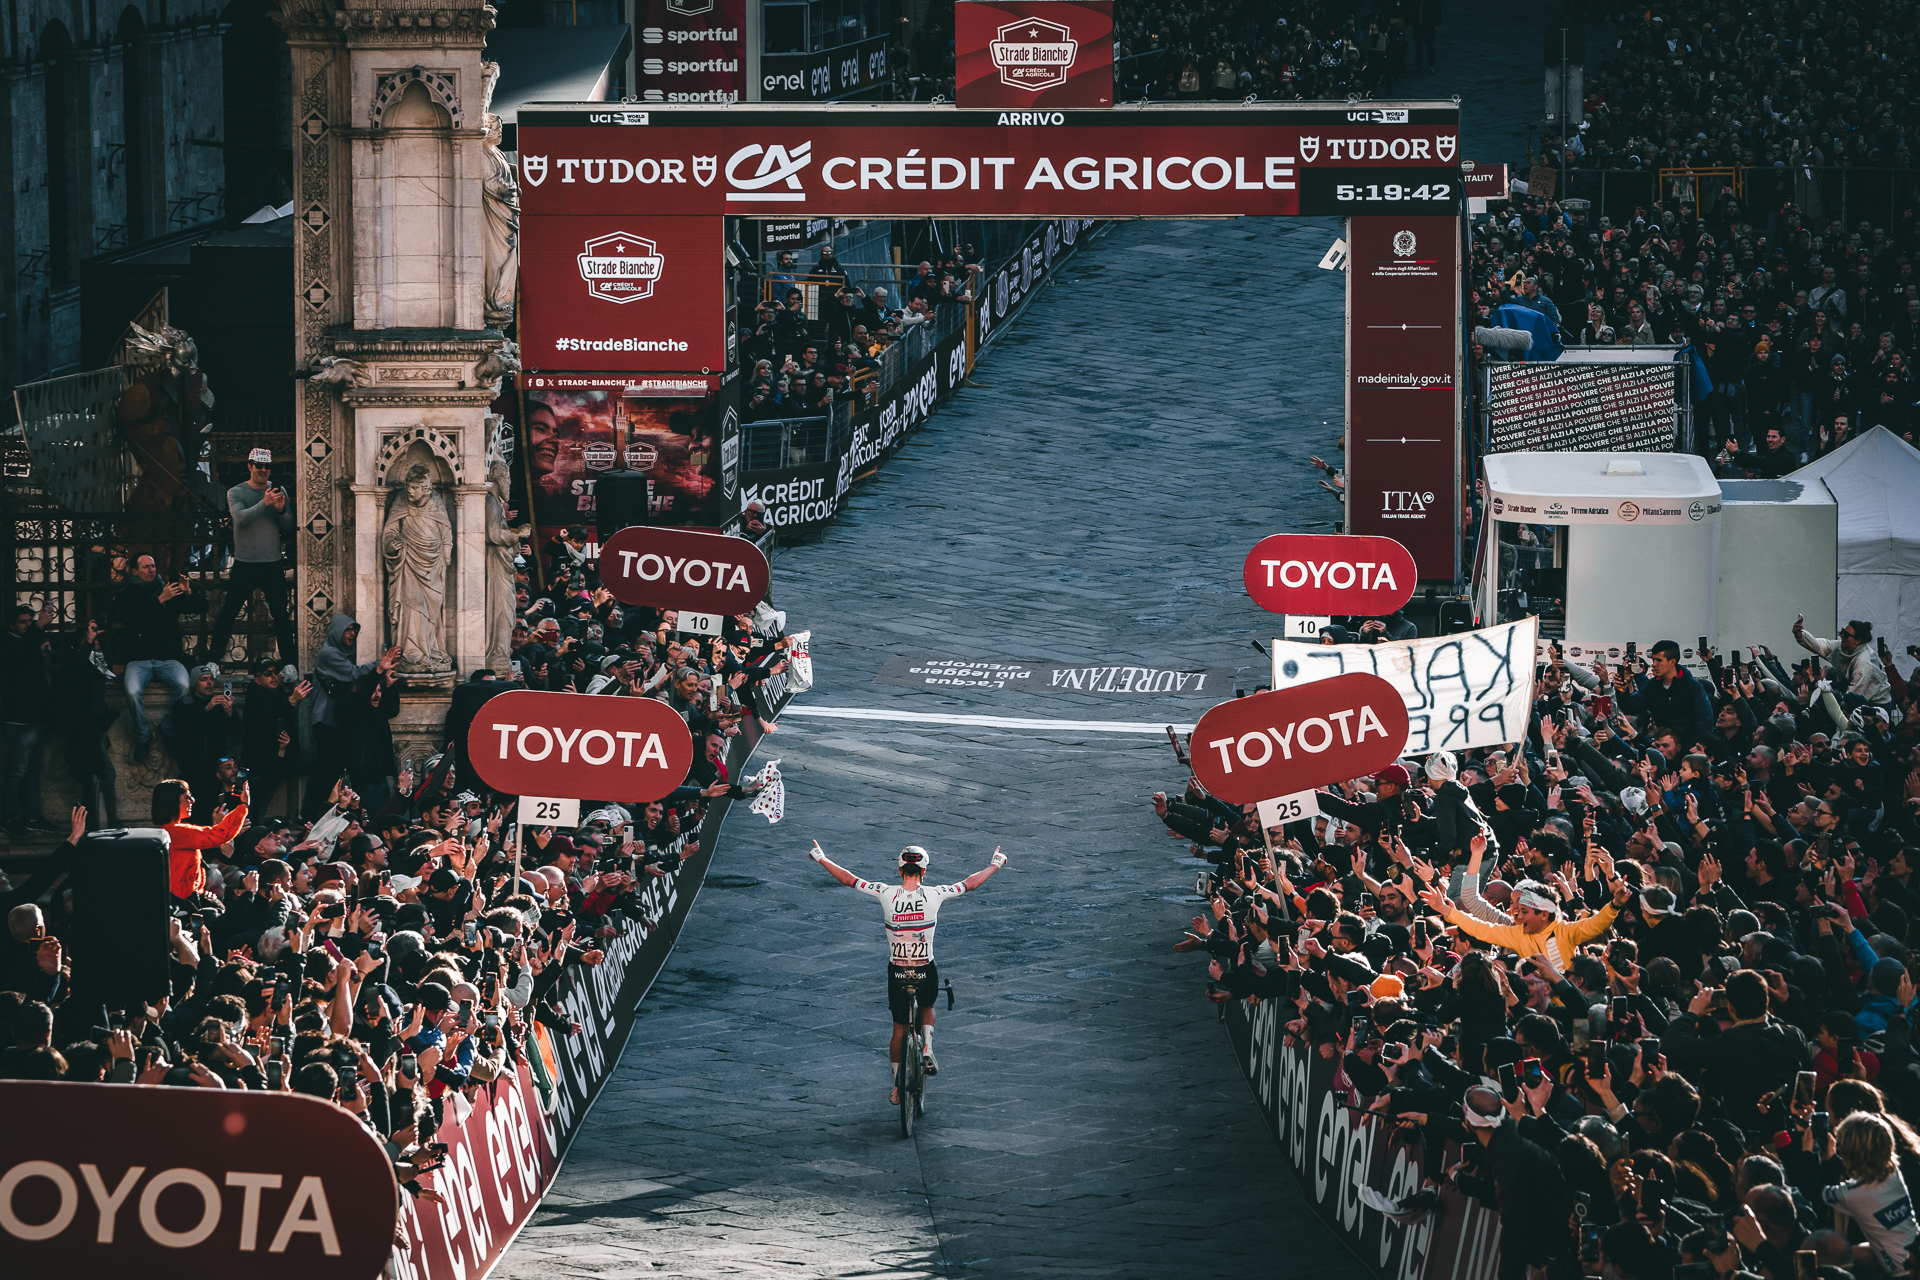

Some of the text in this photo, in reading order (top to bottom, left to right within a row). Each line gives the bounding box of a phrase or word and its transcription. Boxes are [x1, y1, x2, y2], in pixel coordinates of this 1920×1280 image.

[667, 27, 738, 44] sportful
[869, 42, 886, 80] enel
[999, 46, 1069, 62] Strade Bianche
[667, 58, 738, 75] sportful
[811, 57, 831, 96] enel
[841, 49, 859, 88] enel
[764, 70, 805, 91] enel
[590, 114, 611, 123] UCI
[997, 112, 1064, 126] ARRIVO
[1347, 112, 1369, 122] UCI
[1326, 138, 1431, 160] TUDOR
[556, 158, 686, 184] TUDOR
[822, 148, 1014, 191] CRÉDIT
[1024, 156, 1296, 192] AGRICOLE
[1464, 174, 1494, 183] ITALITY
[1336, 184, 1450, 201] 5:19:42
[775, 222, 800, 231] sportful
[775, 232, 800, 242] sportful
[587, 260, 655, 275] Strade Bianche
[555, 337, 689, 352] #StradeBianche
[558, 379, 636, 387] STRADE-BIANCHE.IT
[1357, 372, 1452, 387] madeinitaly.gov.it
[1520, 369, 1645, 403] CHE SI ALZI LA POLVERE CHE SI ALZI LA
[1519, 402, 1534, 412] CHE
[1543, 397, 1557, 407] ALZI
[1558, 395, 1567, 403] LA
[1568, 388, 1598, 401] POLVERE
[1599, 385, 1613, 394] CHE
[1615, 383, 1621, 391] SI
[1623, 380, 1635, 389] ALZI
[1637, 378, 1645, 386] LA
[1646, 371, 1674, 384] POLVERE
[1492, 414, 1522, 427] POLVERE
[1524, 411, 1537, 420] CHE
[1547, 406, 1560, 415] ALZI
[1571, 397, 1598, 409] POLVERE
[1601, 393, 1615, 403] CHE
[1624, 388, 1639, 397] ALZI
[1640, 386, 1648, 394] LA
[1493, 423, 1521, 435] POLVERE
[1523, 419, 1537, 428] CHE
[1547, 414, 1561, 423] ALZI
[1562, 412, 1570, 420] LA
[1572, 405, 1602, 417] POLVERE
[1603, 402, 1616, 411] CHE
[1627, 397, 1639, 405] ALZI
[1497, 440, 1525, 452] POLVERE
[1527, 436, 1541, 445] CHE
[1542, 434, 1548, 442] SI
[1550, 431, 1564, 440] ALZI
[1575, 422, 1605, 434] POLVERE
[571, 479, 655, 496] STE
[761, 478, 825, 505] CRÉDIT
[576, 495, 675, 511] BIHE
[1382, 491, 1426, 511] ITA
[763, 496, 833, 527] AGRICOLE
[618, 550, 751, 594] TOYOTA
[1260, 560, 1398, 591] TOYOTA
[690, 616, 709, 631] 10
[1298, 621, 1316, 635] 10
[909, 667, 1031, 682] più leggera
[926, 660, 1022, 671] d'Europa
[925, 677, 1005, 689] L'acqua
[1051, 667, 1208, 693] LAURETANA
[492, 723, 669, 770] TOYOTA
[1209, 705, 1389, 774] TOYOTA
[536, 802, 561, 820] 25
[1276, 800, 1302, 821] 25
[895, 900, 924, 913] UAE
[893, 913, 924, 921] Emirates
[1278, 1035, 1312, 1177] enel
[486, 1066, 542, 1225] enel
[1315, 1091, 1379, 1240] enel
[0, 1160, 342, 1256] OYOTA
[432, 1124, 493, 1279] enel
